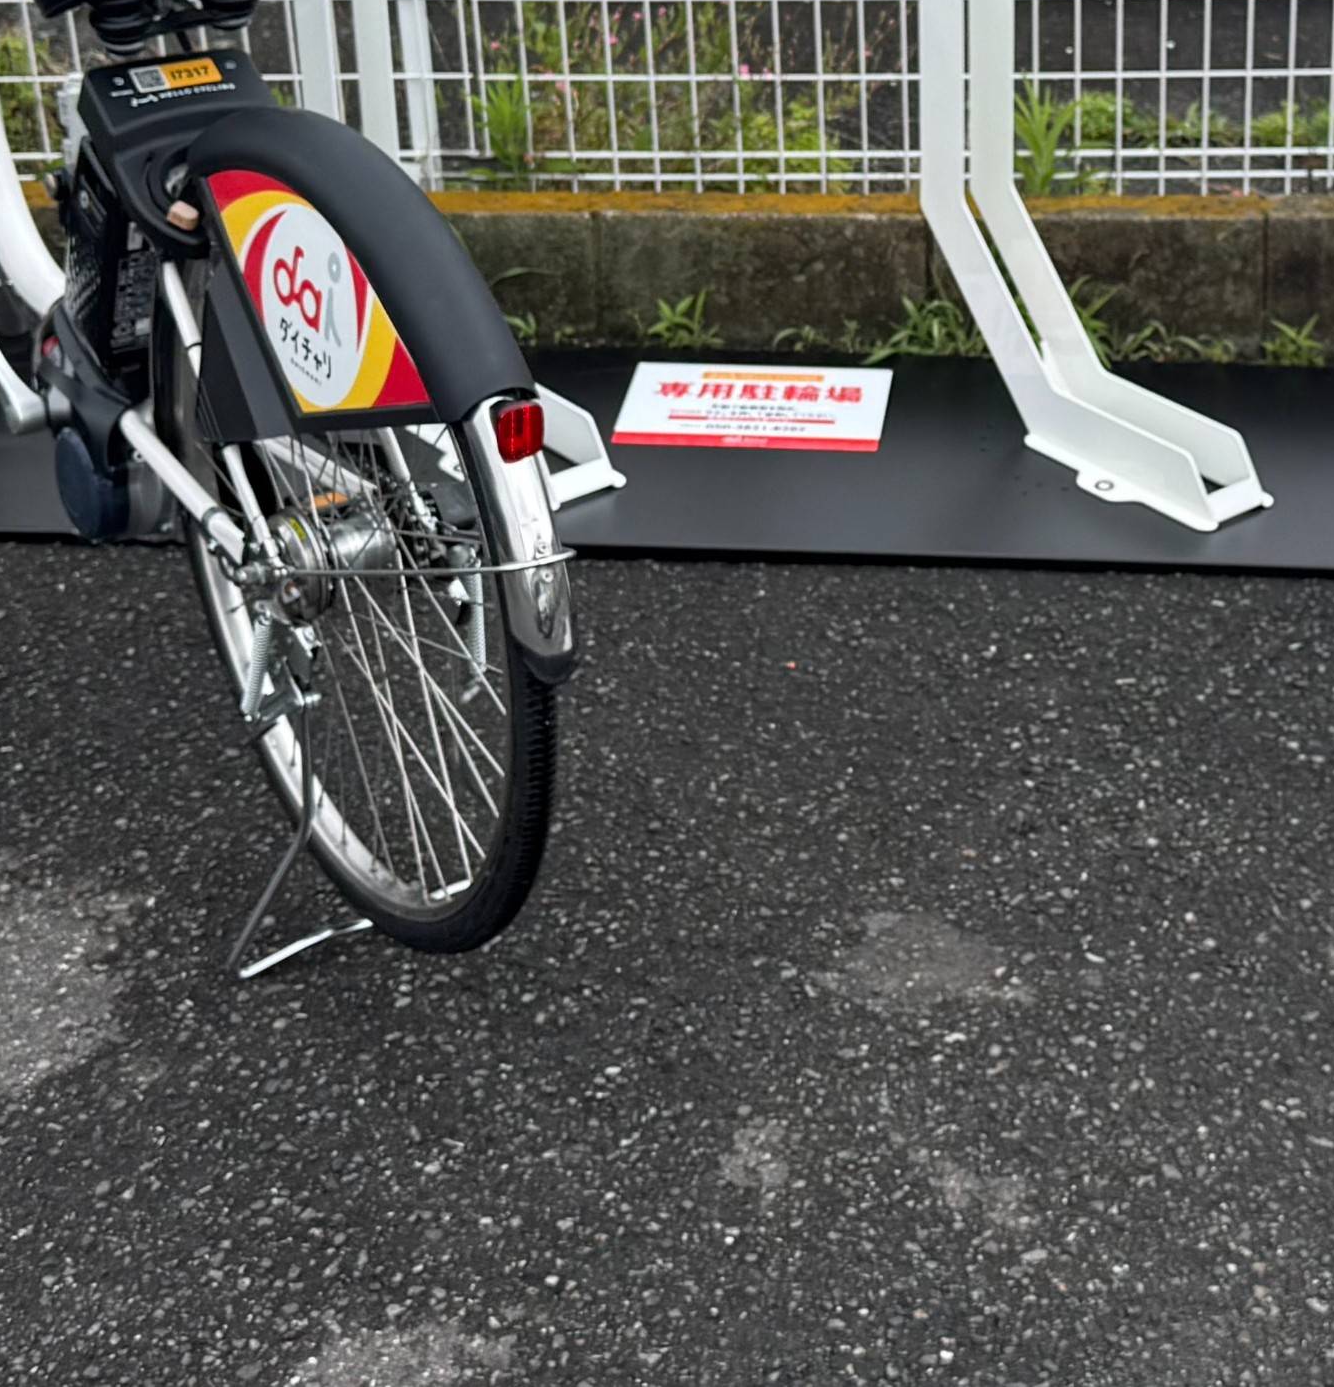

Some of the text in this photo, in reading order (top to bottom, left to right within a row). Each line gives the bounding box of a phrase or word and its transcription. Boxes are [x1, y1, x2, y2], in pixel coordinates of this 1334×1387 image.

[273, 245, 342, 348] dai
[279, 316, 333, 380] ダイチャリ
[653, 381, 863, 404] 専用駐輪場
